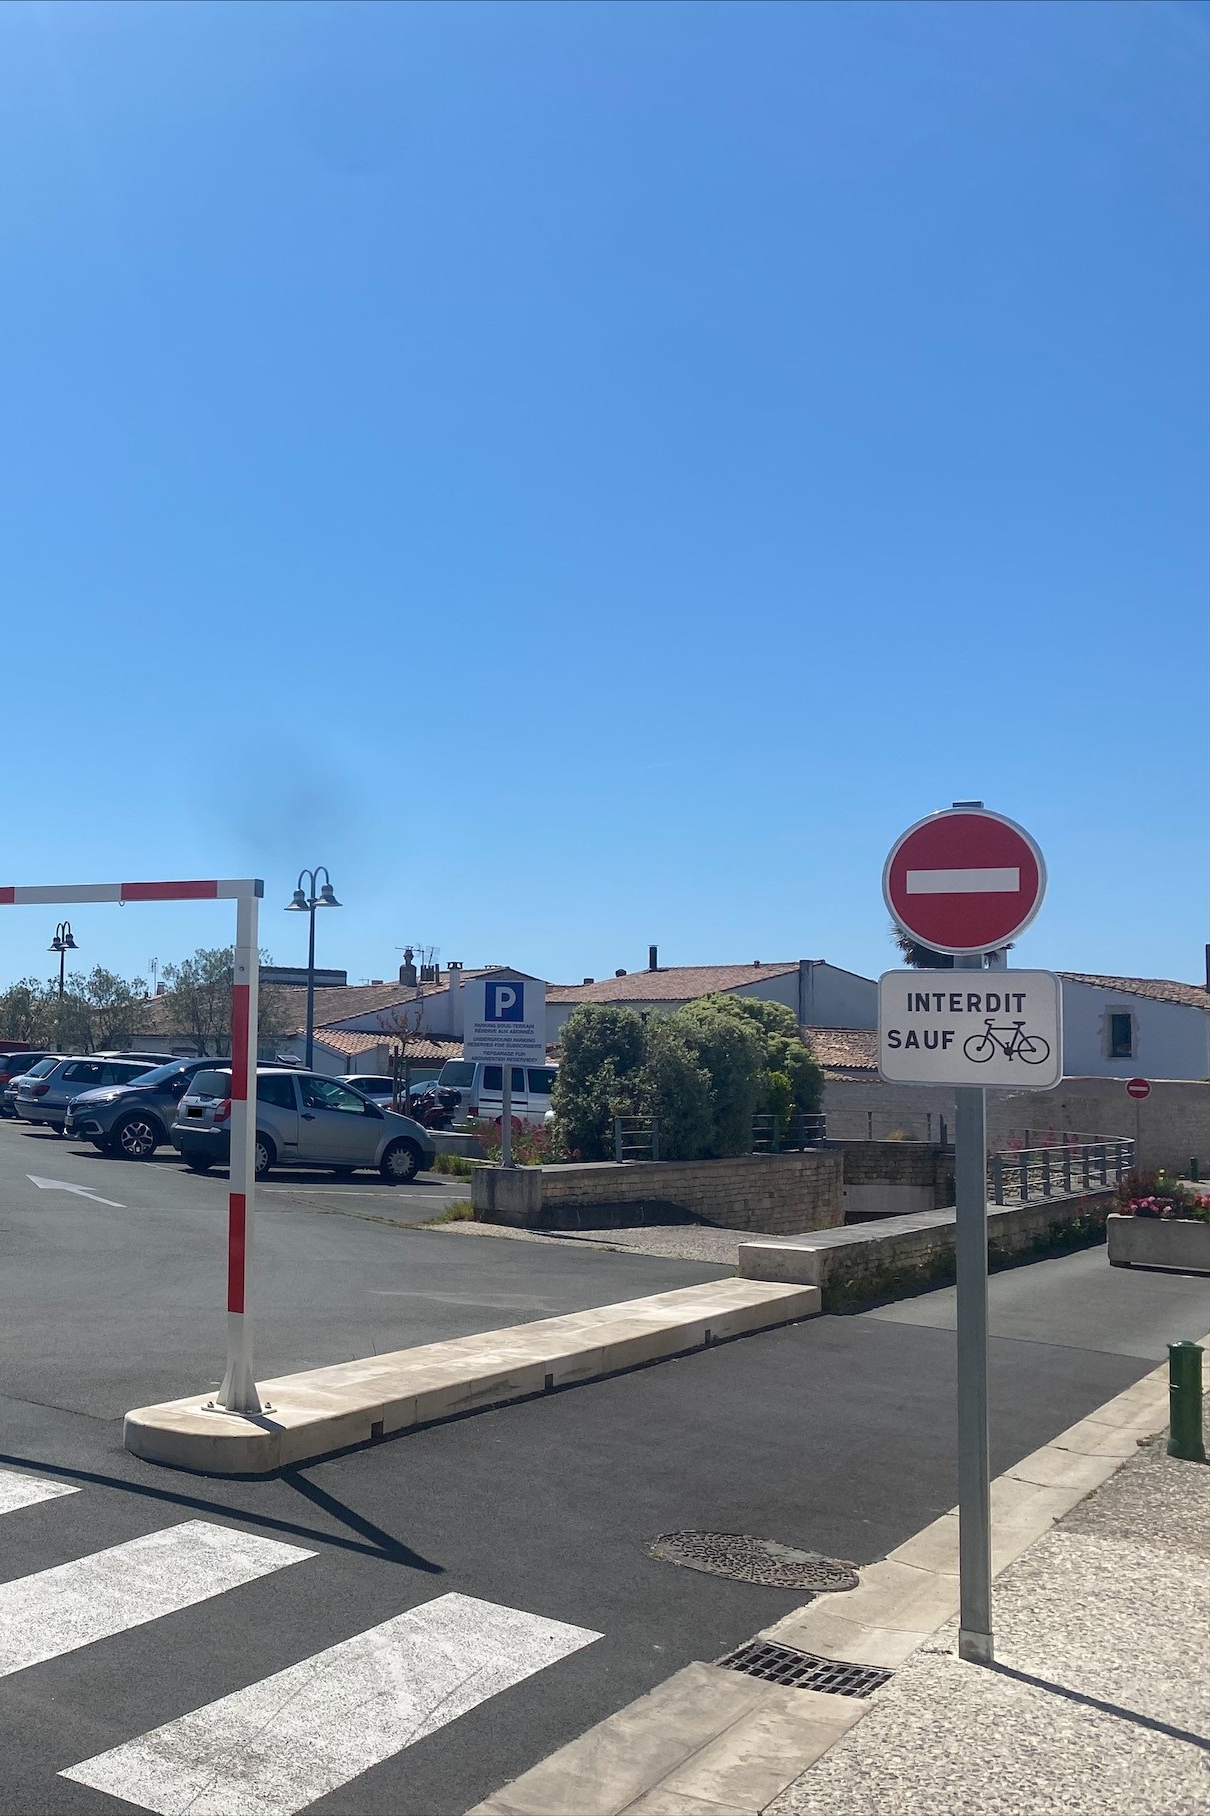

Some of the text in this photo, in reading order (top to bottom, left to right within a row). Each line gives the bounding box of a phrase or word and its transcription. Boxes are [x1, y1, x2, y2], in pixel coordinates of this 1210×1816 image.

[495, 986, 517, 1018] P
[906, 992, 1027, 1014] INTERDIT
[887, 1029, 956, 1052] SAUF
